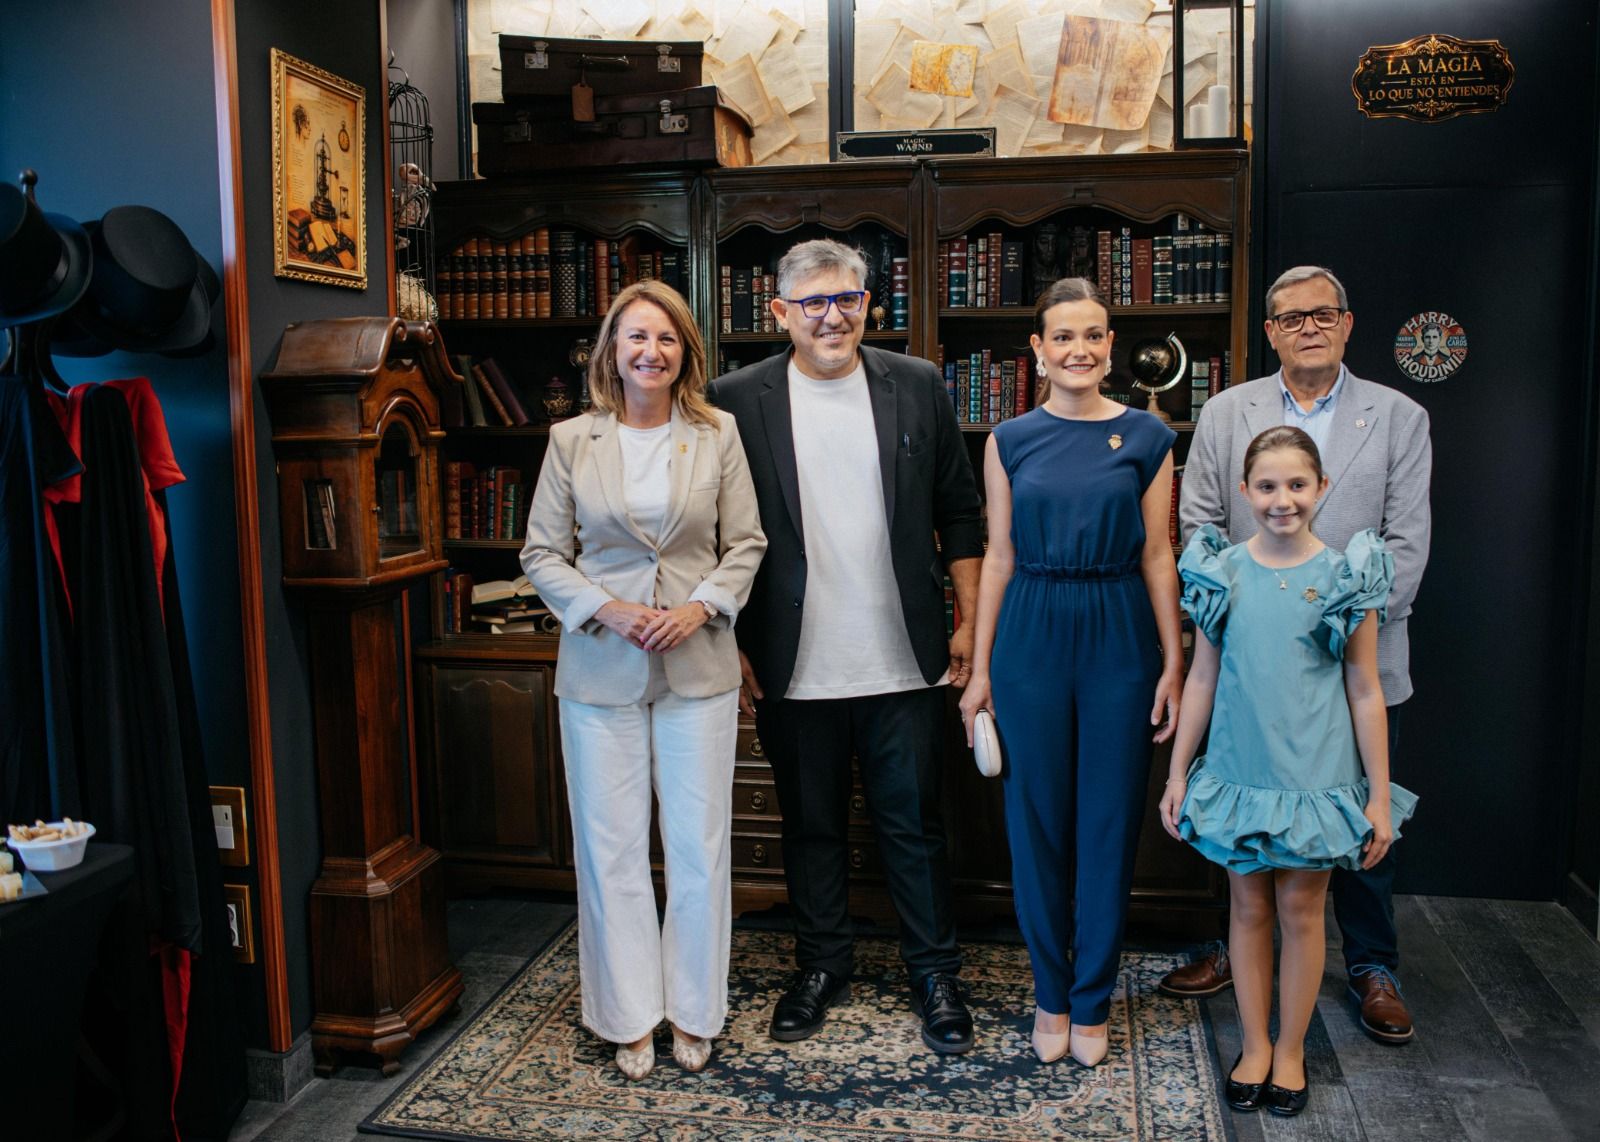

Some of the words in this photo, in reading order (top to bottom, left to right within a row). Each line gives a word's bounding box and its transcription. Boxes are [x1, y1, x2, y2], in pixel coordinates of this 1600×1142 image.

[1386, 58, 1412, 75] LA
[1417, 55, 1483, 74] MAGIA
[1410, 74, 1436, 86] ESTÁ
[1440, 75, 1455, 85] EN
[1368, 89, 1386, 101] LO
[1388, 88, 1413, 101] QUE
[1416, 87, 1435, 98] NO
[1437, 84, 1500, 98] ENTIENDES
[1405, 311, 1459, 333] HARRY
[1447, 339, 1467, 347] CARDS
